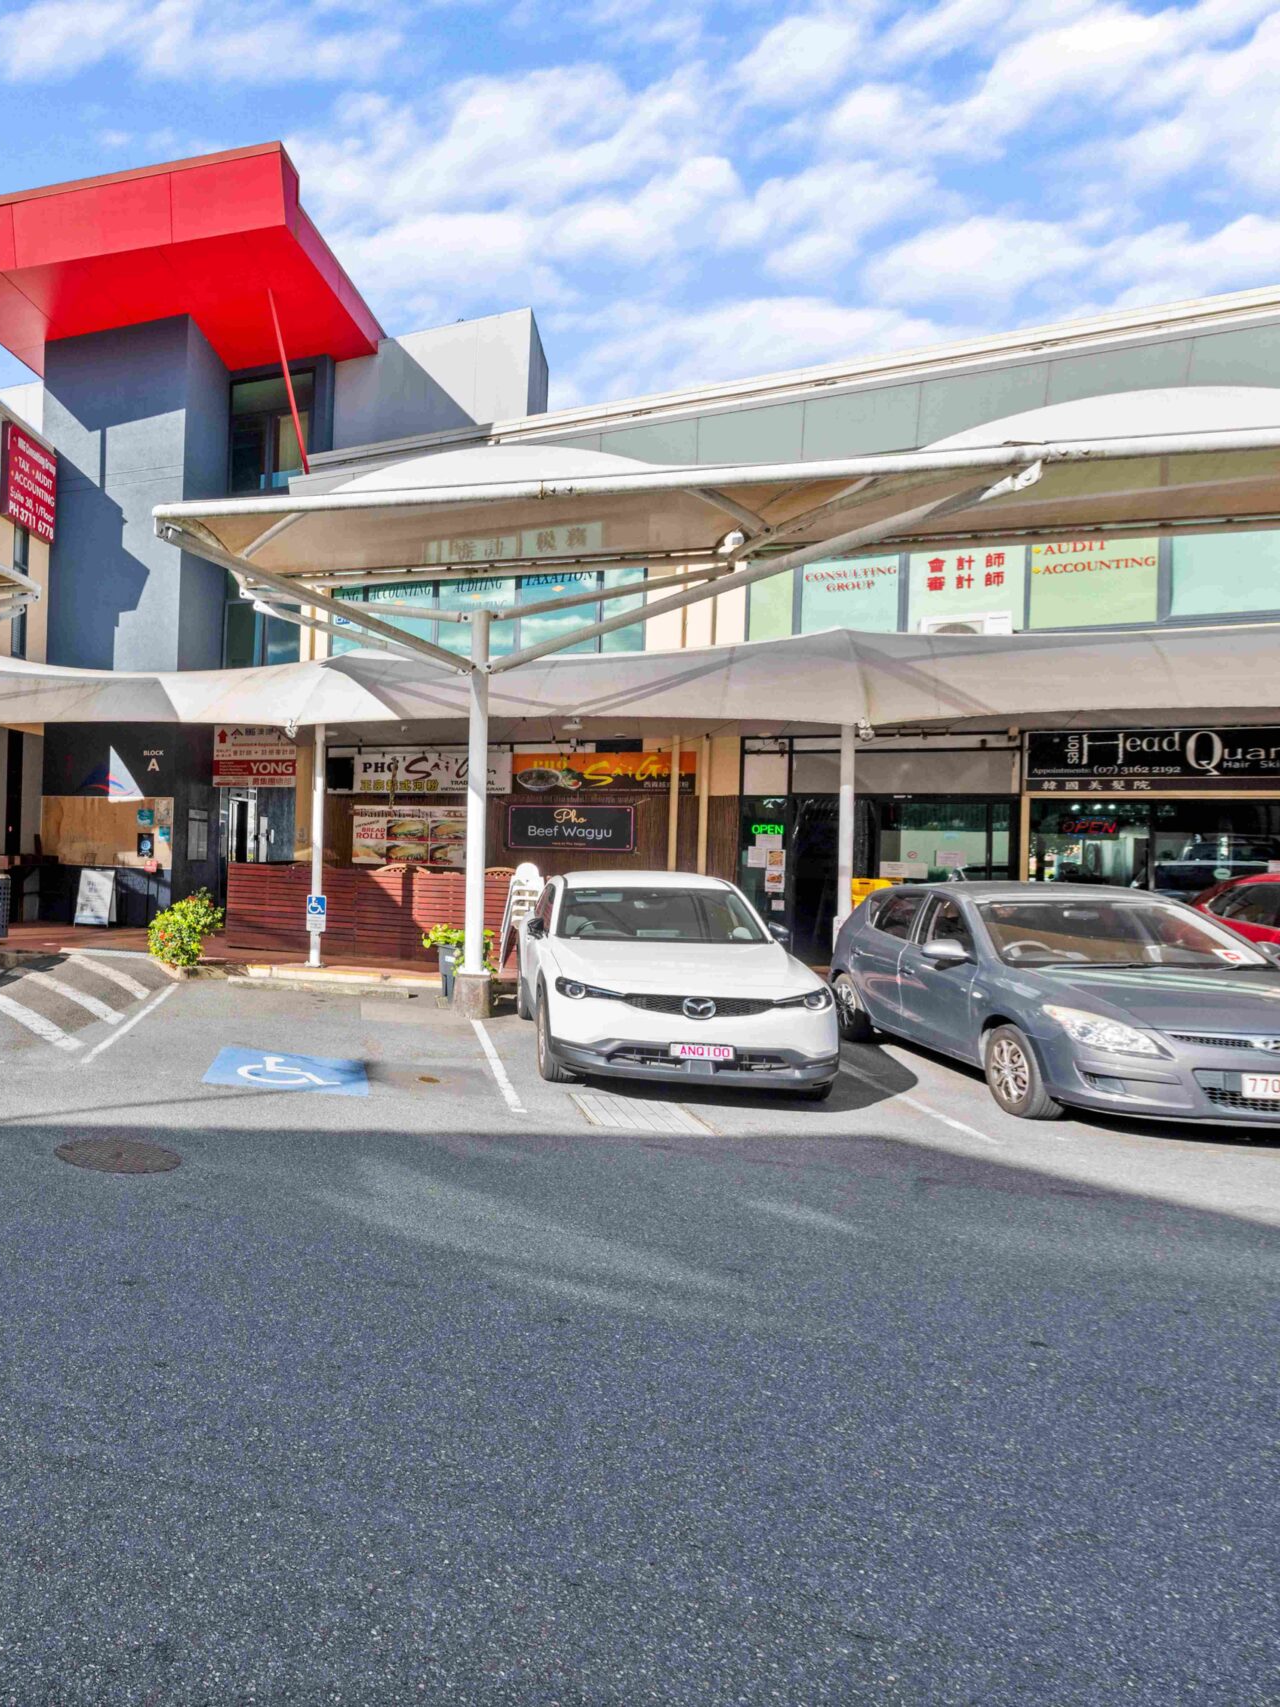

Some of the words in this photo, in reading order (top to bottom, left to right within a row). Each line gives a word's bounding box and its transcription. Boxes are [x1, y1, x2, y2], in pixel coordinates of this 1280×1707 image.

[35, 470, 53, 490] AUDIT
[14, 471, 55, 507] ACCOUNTING
[9, 500, 19, 517] PH
[19, 508, 37, 529] 3711
[1043, 541, 1107, 556] AUDIT
[927, 552, 1006, 573] 會計師
[1041, 556, 1157, 576] ACCOUNTING
[525, 571, 594, 587] TAXATION
[805, 565, 897, 583] CONSULTING
[926, 571, 1006, 592] 審計師
[369, 583, 432, 601] ACCOUNTING
[453, 576, 504, 593] AUDITING
[825, 580, 875, 593] GROUP
[1066, 735, 1080, 765] salon
[1081, 731, 1181, 765] Head
[147, 758, 160, 771] A
[250, 762, 293, 774] YONG
[1093, 765, 1118, 775] (07)
[1120, 765, 1150, 774] 3162
[1151, 765, 1181, 774] 2192
[1223, 760, 1251, 769] Hair
[554, 809, 587, 824] Pho
[528, 826, 559, 837] Beef
[562, 826, 612, 840] Wagyu
[751, 824, 784, 835] OPEN
[1062, 820, 1117, 835] OPEN
[356, 832, 385, 840] ROLLS
[1248, 1077, 1280, 1093] 770
